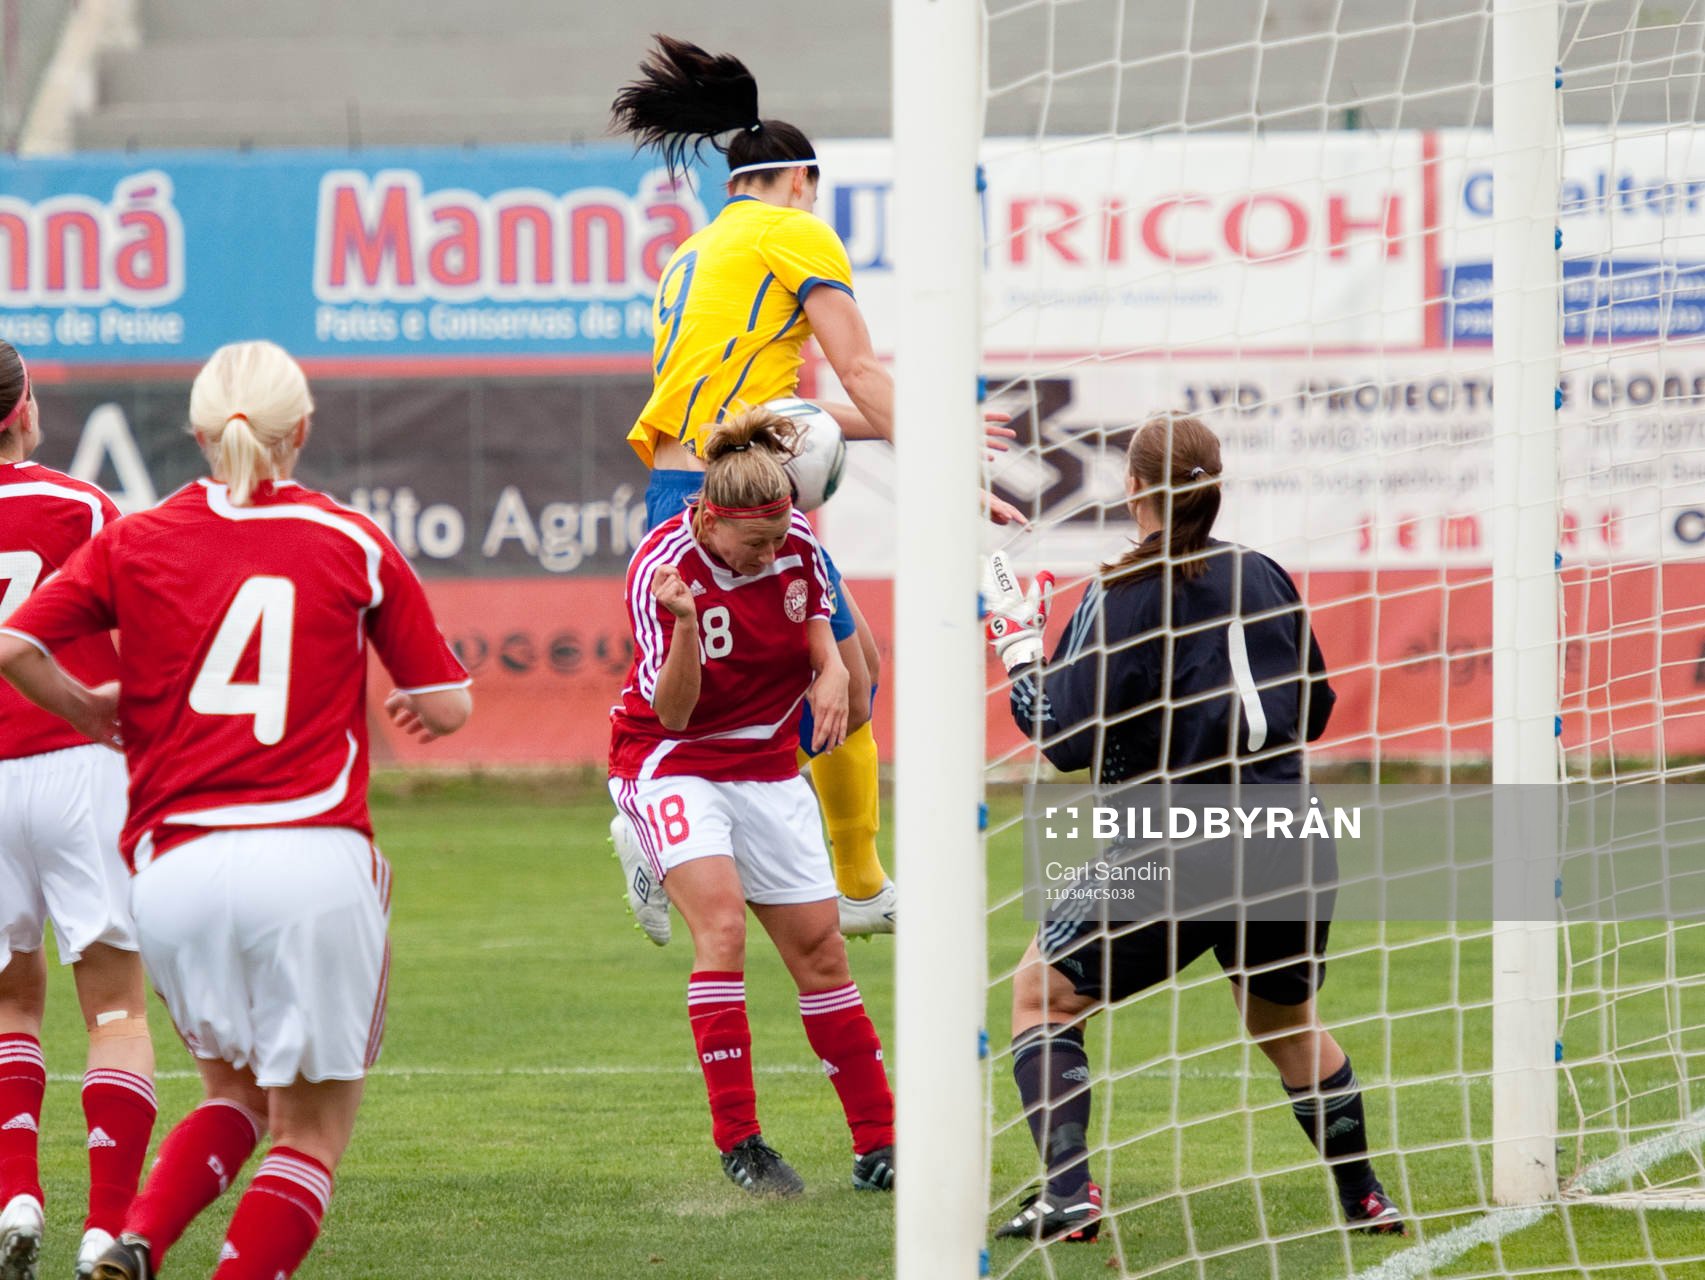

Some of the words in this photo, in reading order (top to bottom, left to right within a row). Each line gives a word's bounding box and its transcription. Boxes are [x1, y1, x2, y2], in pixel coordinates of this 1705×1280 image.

[322, 175, 696, 294] Manná
[656, 250, 698, 376] 9
[993, 556, 1014, 593] SELECT
[188, 575, 296, 746] 4
[1227, 620, 1268, 752] 1
[647, 794, 690, 853] 18
[702, 1048, 742, 1064] DBU
